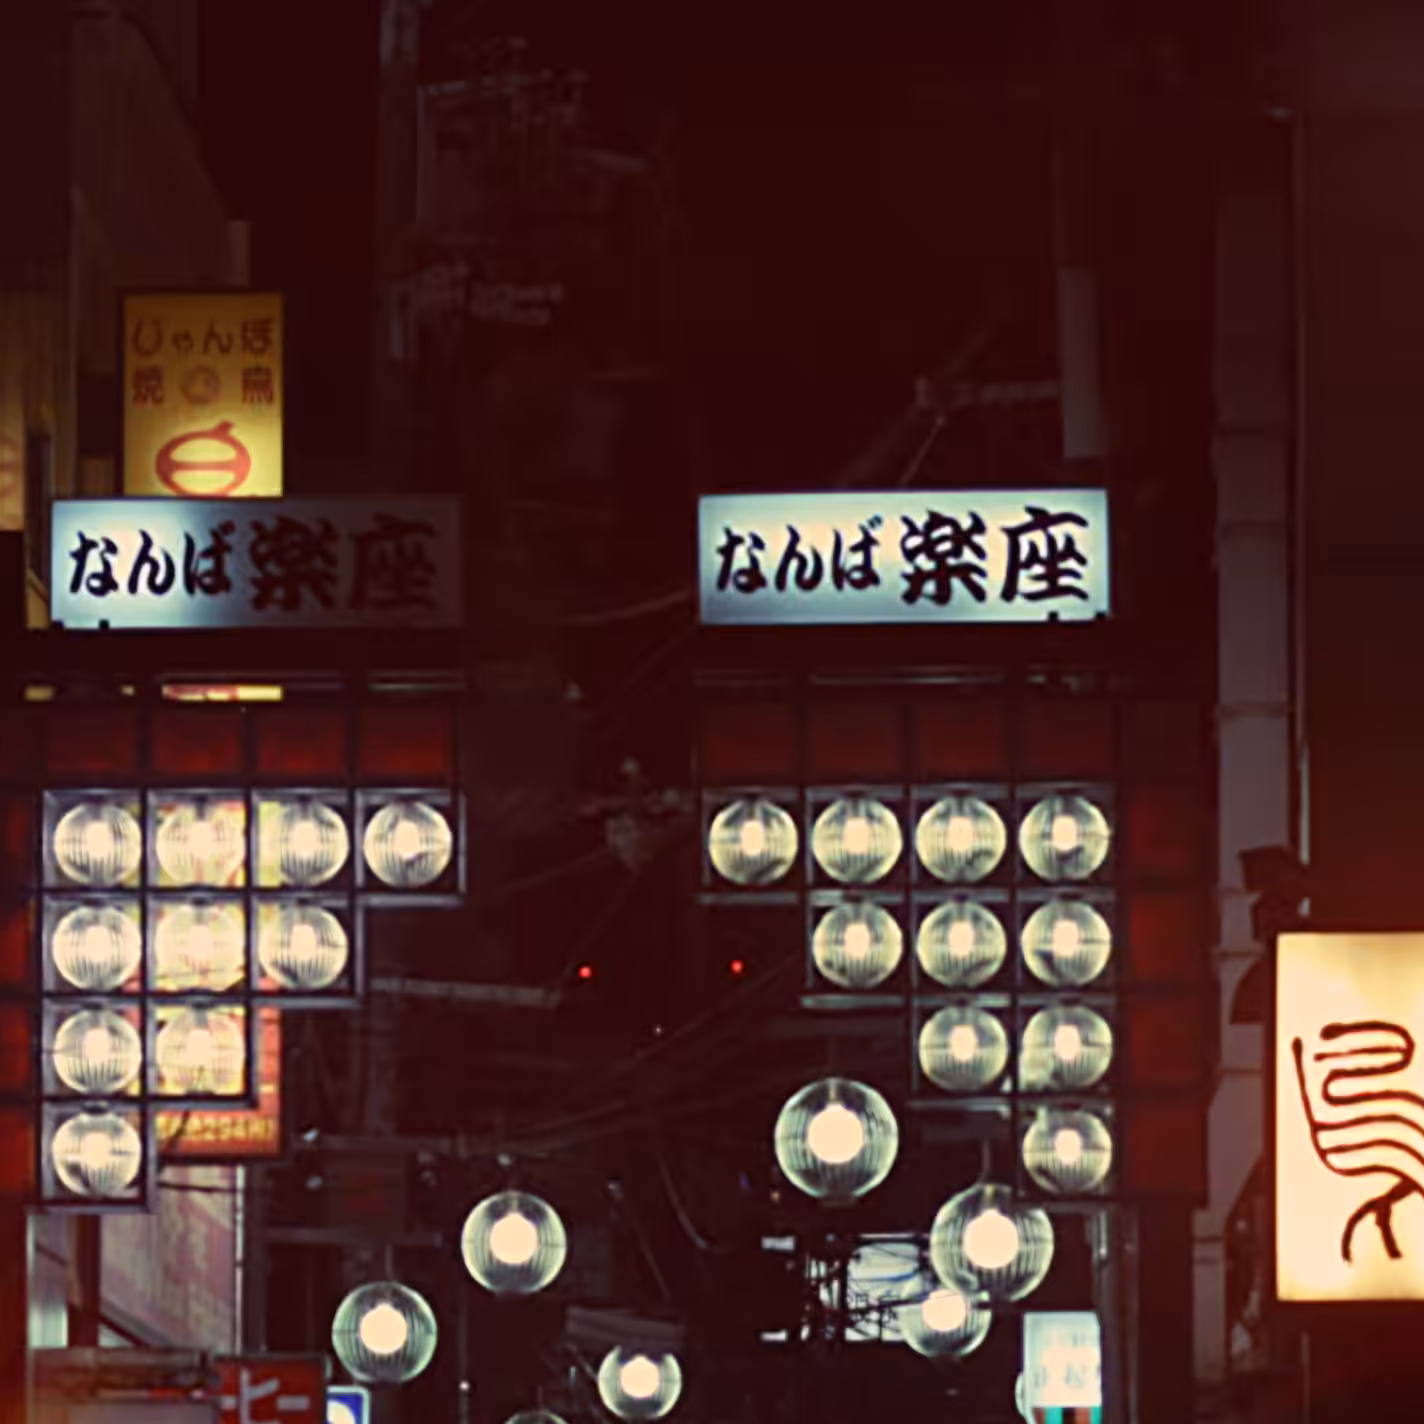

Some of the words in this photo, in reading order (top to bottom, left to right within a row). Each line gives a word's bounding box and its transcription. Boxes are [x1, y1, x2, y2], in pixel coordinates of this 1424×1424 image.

[68, 514, 442, 612] なんば楽座
[715, 505, 1090, 606] なんば楽座
